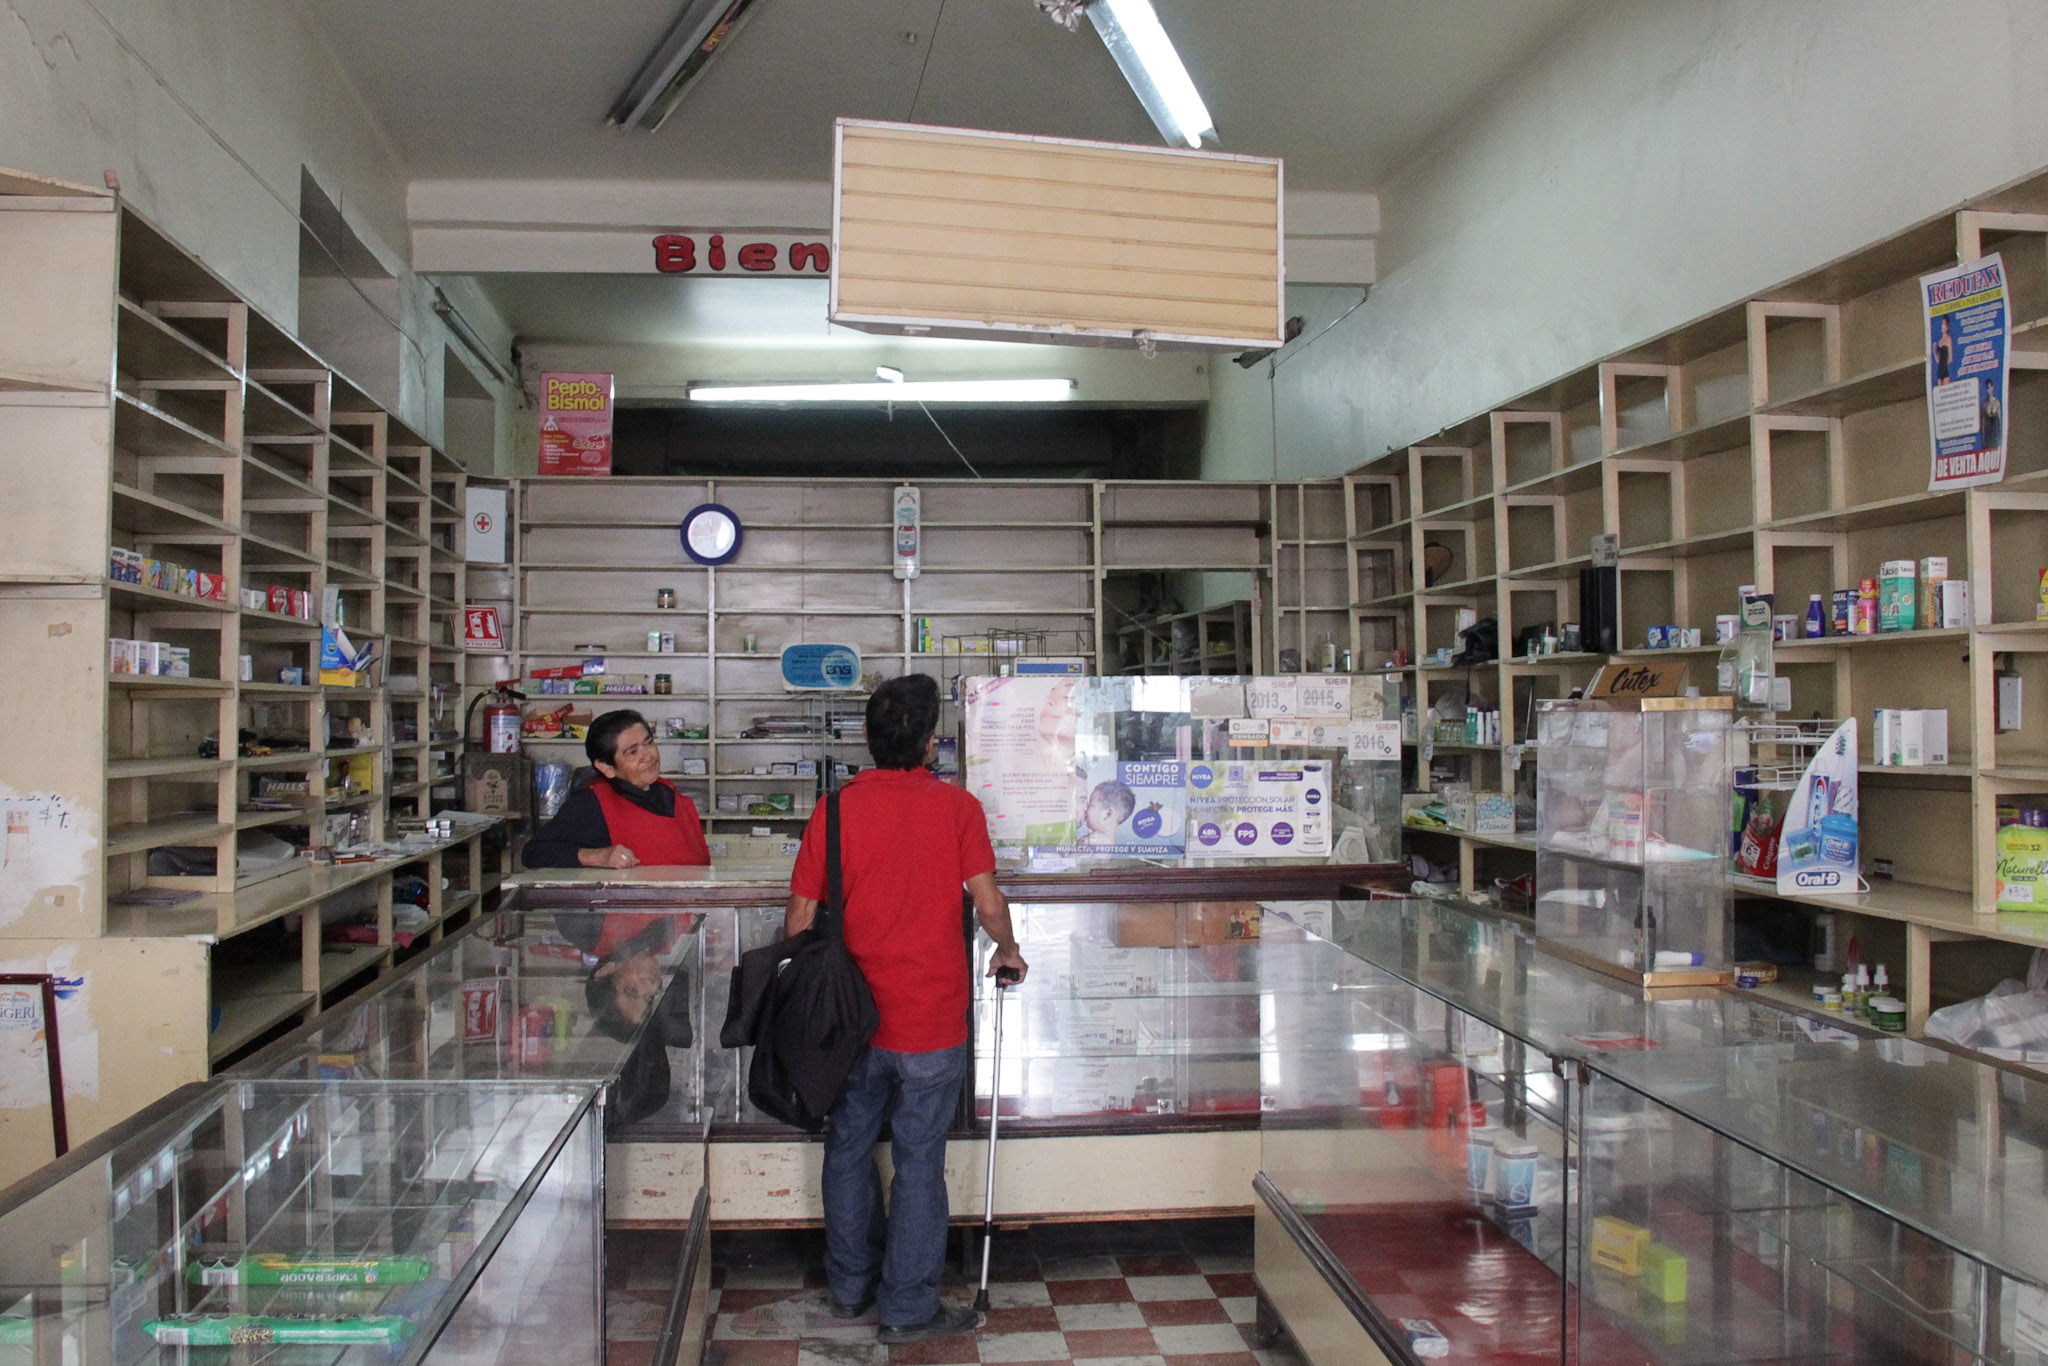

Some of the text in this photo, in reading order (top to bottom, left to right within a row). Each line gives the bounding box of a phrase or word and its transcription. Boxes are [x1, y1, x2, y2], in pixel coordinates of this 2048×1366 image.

[652, 234, 830, 273] Bien
[1930, 266, 2001, 304] REDUFAX
[547, 379, 602, 396] Pepto-
[547, 394, 605, 411] Bismol
[1937, 458, 1948, 478] DE
[1949, 453, 1977, 476] VENTA
[1609, 666, 1663, 694] Cutex
[1250, 692, 1279, 709] 2013
[1303, 689, 1334, 706] 2015
[1375, 723, 1399, 731] SIEM
[1354, 734, 1385, 750] 2016
[1124, 764, 1179, 773] CONTIGO
[1124, 773, 1179, 785] SIEMPRE
[266, 782, 306, 791] HALLS
[1189, 796, 1216, 804] NIVEA
[1218, 794, 1269, 804] PROTECCIÓN
[1137, 816, 1156, 826] NIVEA
[1238, 829, 1255, 838] FPS
[1095, 845, 1129, 853] PROTEGE
[1137, 846, 1168, 854] SUAVIZA
[1762, 836, 1777, 871] Colgate
[2030, 844, 2041, 852] 32
[1797, 873, 1840, 886] Oral-B
[279, 1272, 359, 1282] EMPERADOR
